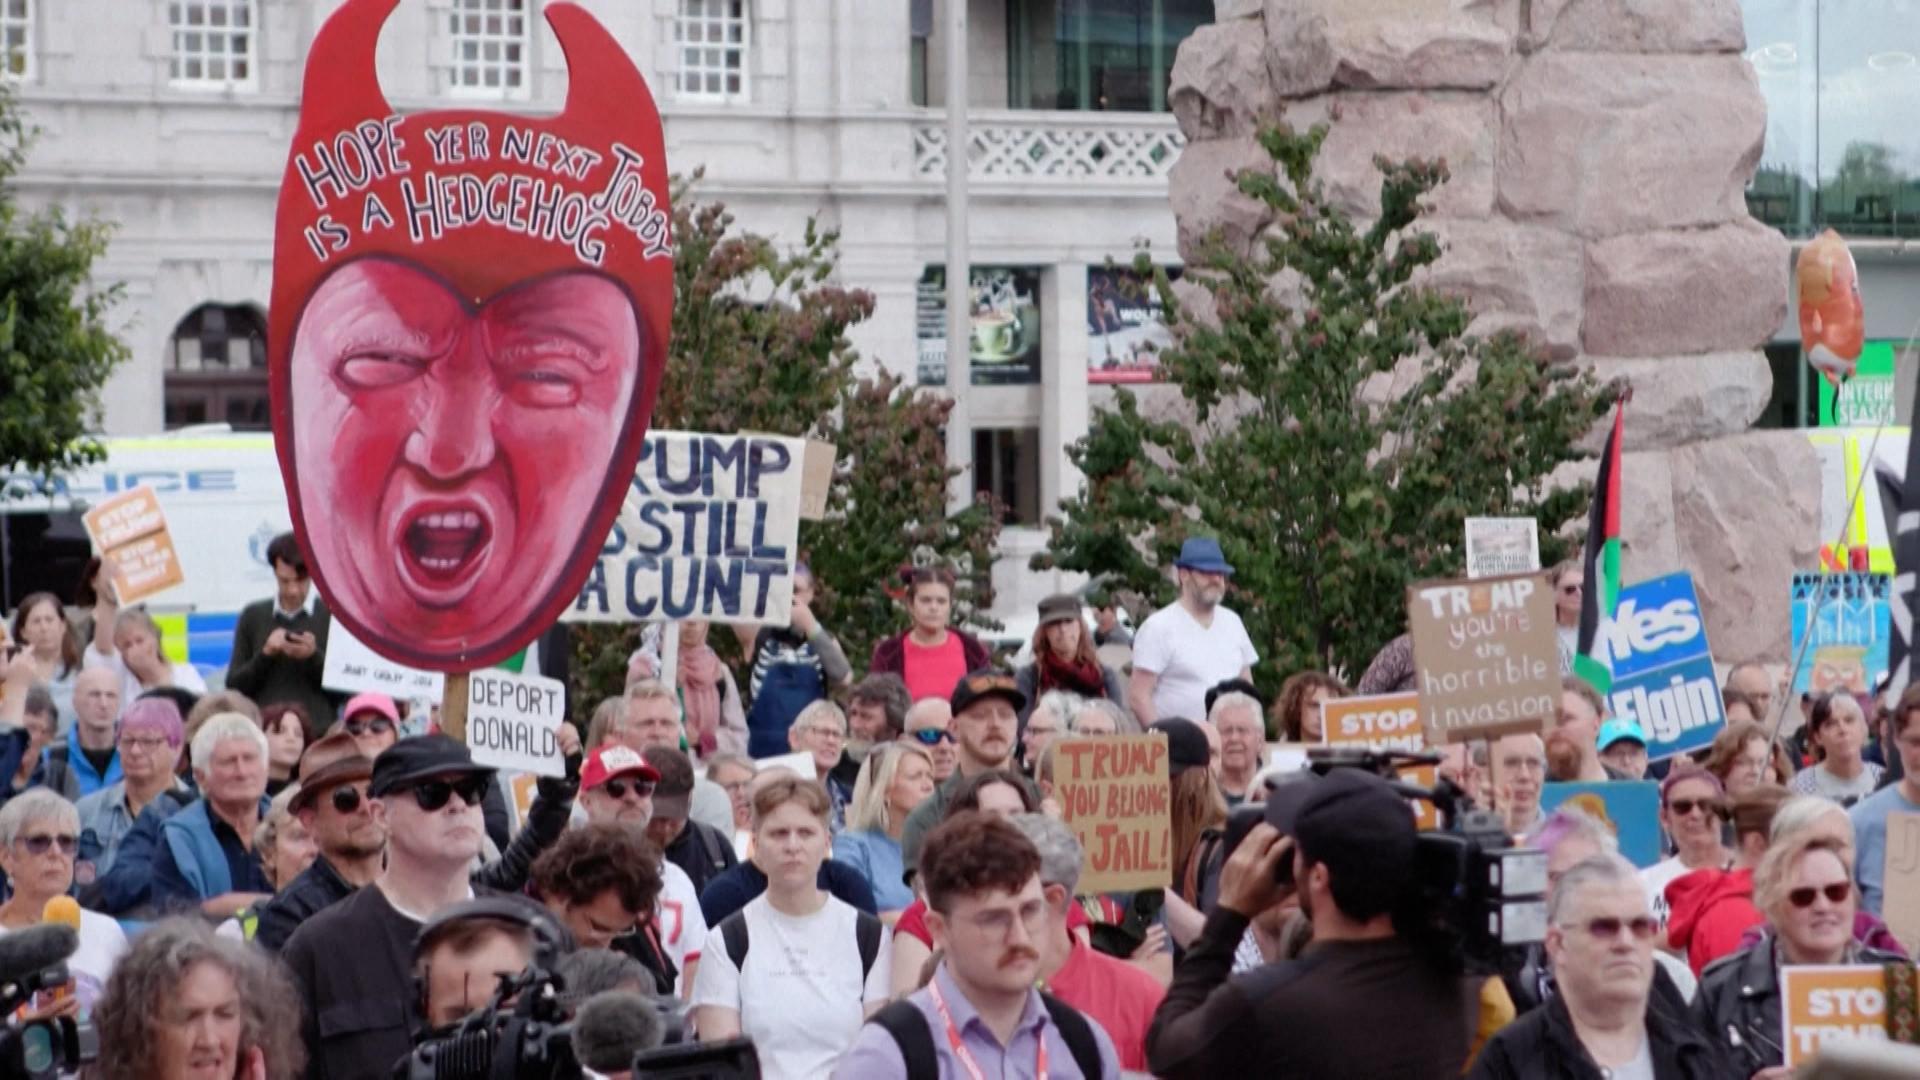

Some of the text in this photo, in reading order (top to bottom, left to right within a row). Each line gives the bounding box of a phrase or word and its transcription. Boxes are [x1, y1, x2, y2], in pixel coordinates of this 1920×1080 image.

[295, 115, 673, 260] HOPE YER NEXT JOBBY
[304, 171, 611, 268] IS A HEDGEHOG
[632, 437, 790, 498] RUMP
[638, 500, 787, 560] STILL
[625, 557, 789, 619] CUNT
[1448, 611, 1530, 649] you're
[1603, 598, 1701, 661] Yes
[1424, 655, 1547, 695] horrible
[472, 677, 558, 716] DEPORT
[1431, 695, 1553, 730] invasion
[1612, 674, 1721, 744] Elgin
[473, 716, 556, 758] DONALD
[1341, 708, 1417, 735] STOP
[1060, 742, 1166, 780] TRUMP
[1060, 783, 1168, 824] YOU BELONG
[1091, 823, 1169, 872] JAIL!
[1807, 987, 1887, 1017] STO
